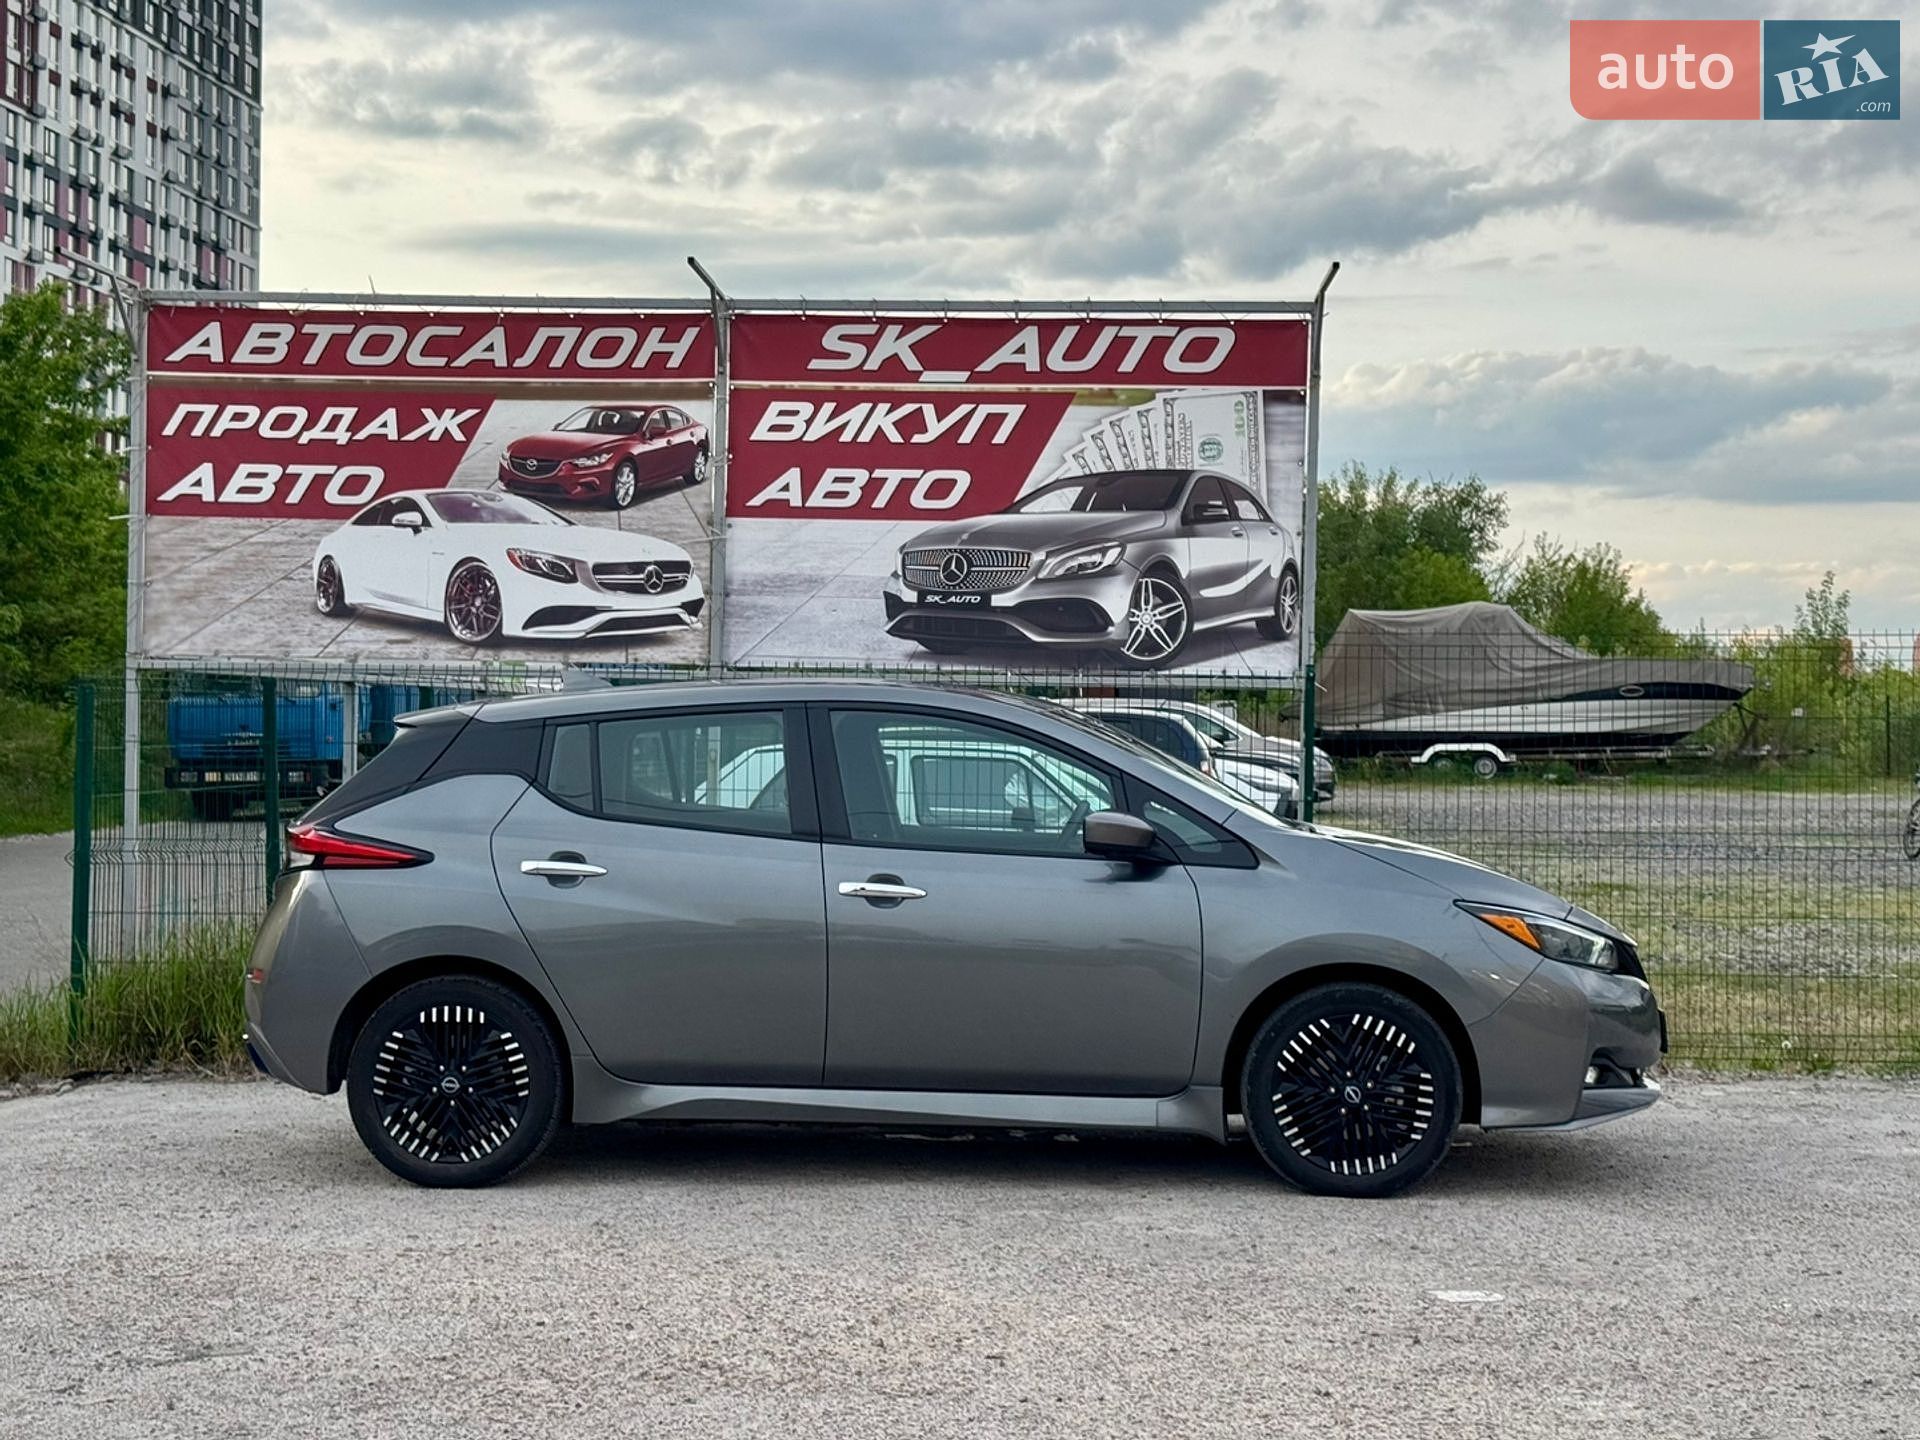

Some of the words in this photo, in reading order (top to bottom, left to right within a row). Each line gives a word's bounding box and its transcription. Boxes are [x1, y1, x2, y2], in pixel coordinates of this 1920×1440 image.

[164, 320, 702, 369] АВТОСАЛОН
[808, 324, 1236, 382] SK_AUTO
[161, 402, 481, 446] ПРОДАЖ
[748, 400, 1027, 445] ВИКУП
[157, 462, 386, 505] АВТО
[745, 467, 972, 508] АВТО
[924, 594, 981, 604] SK_AUTO
